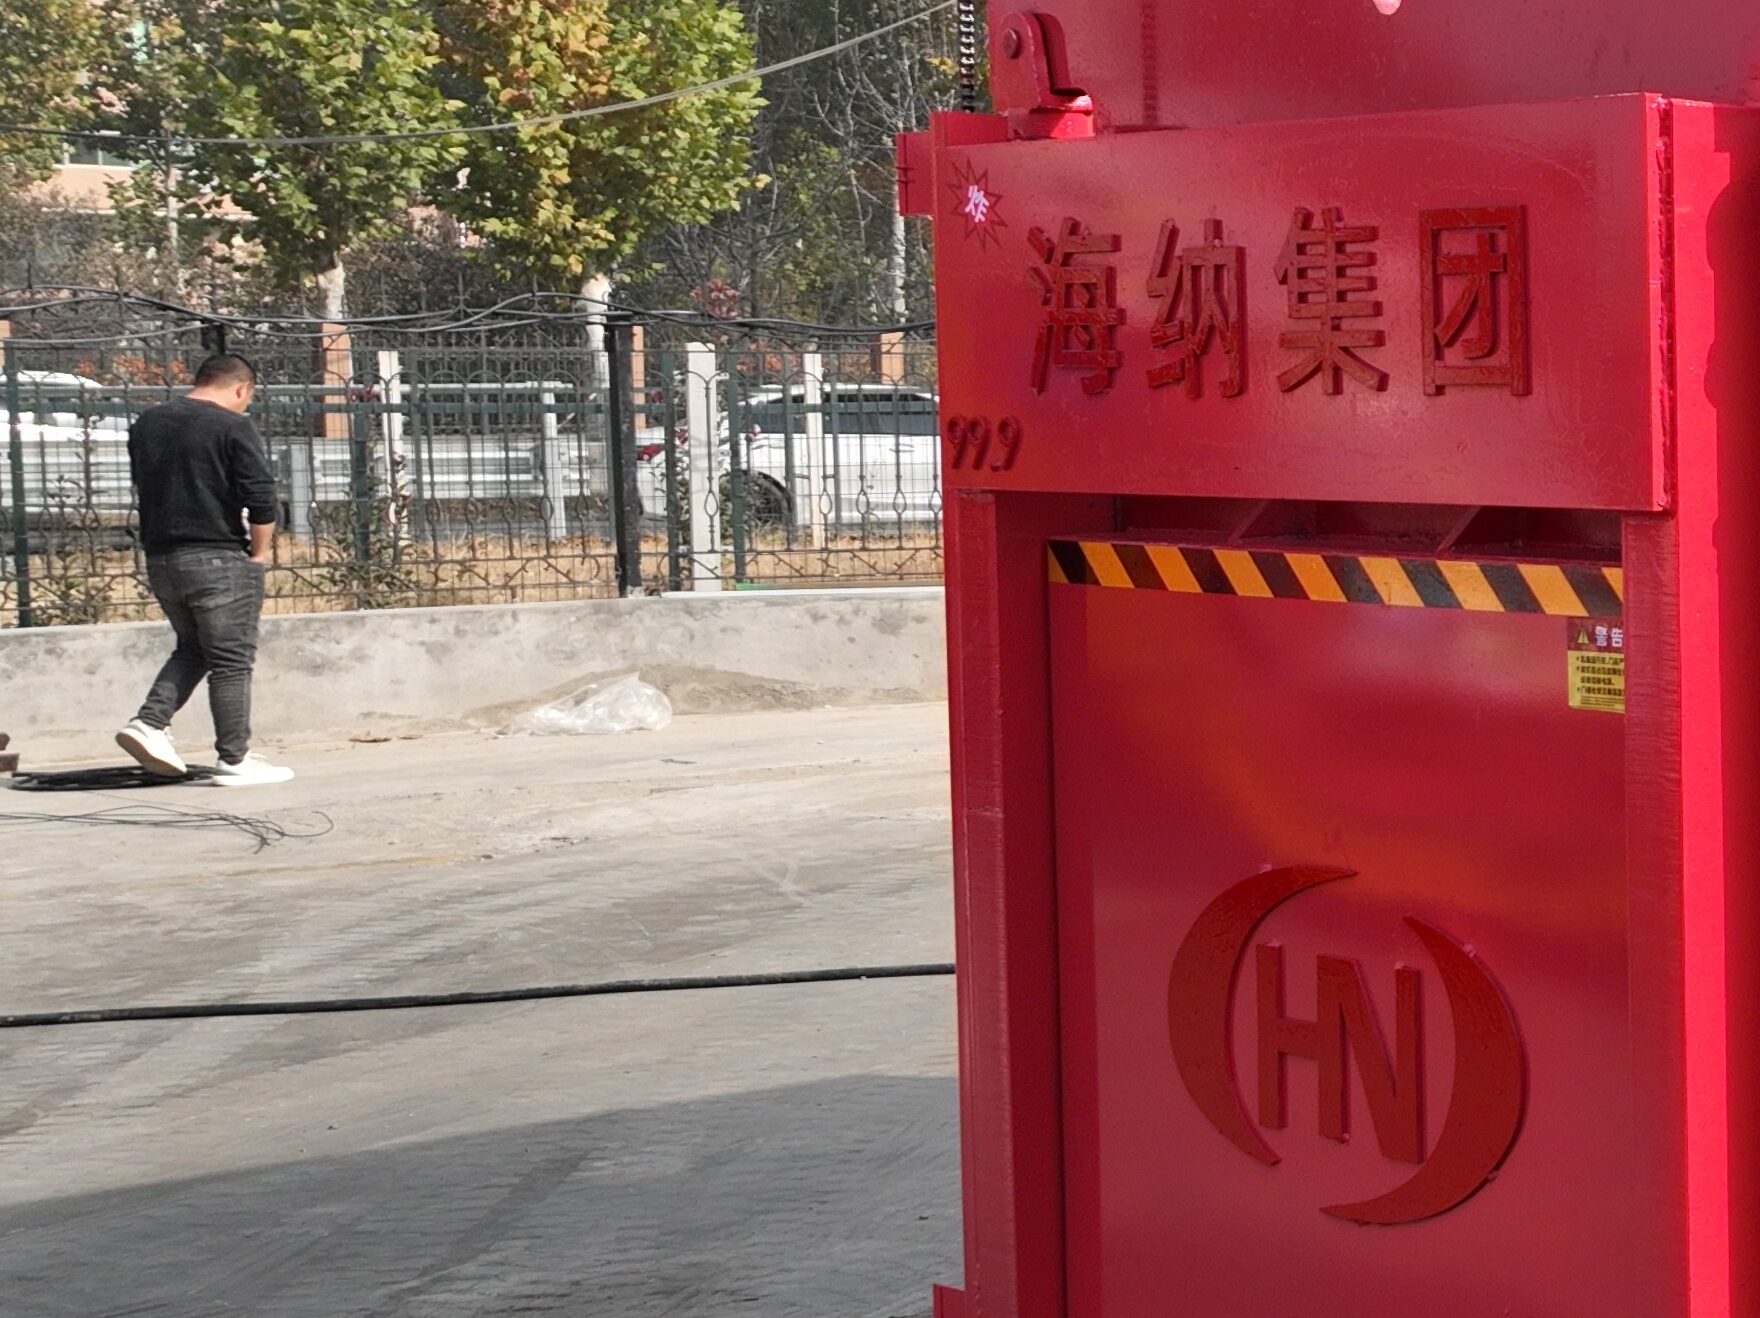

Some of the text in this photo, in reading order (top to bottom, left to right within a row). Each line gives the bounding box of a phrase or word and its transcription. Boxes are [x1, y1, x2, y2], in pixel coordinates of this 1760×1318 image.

[1025, 204, 1533, 399] 海纳集团
[946, 414, 1024, 473] 999
[1255, 937, 1428, 1166] HN
